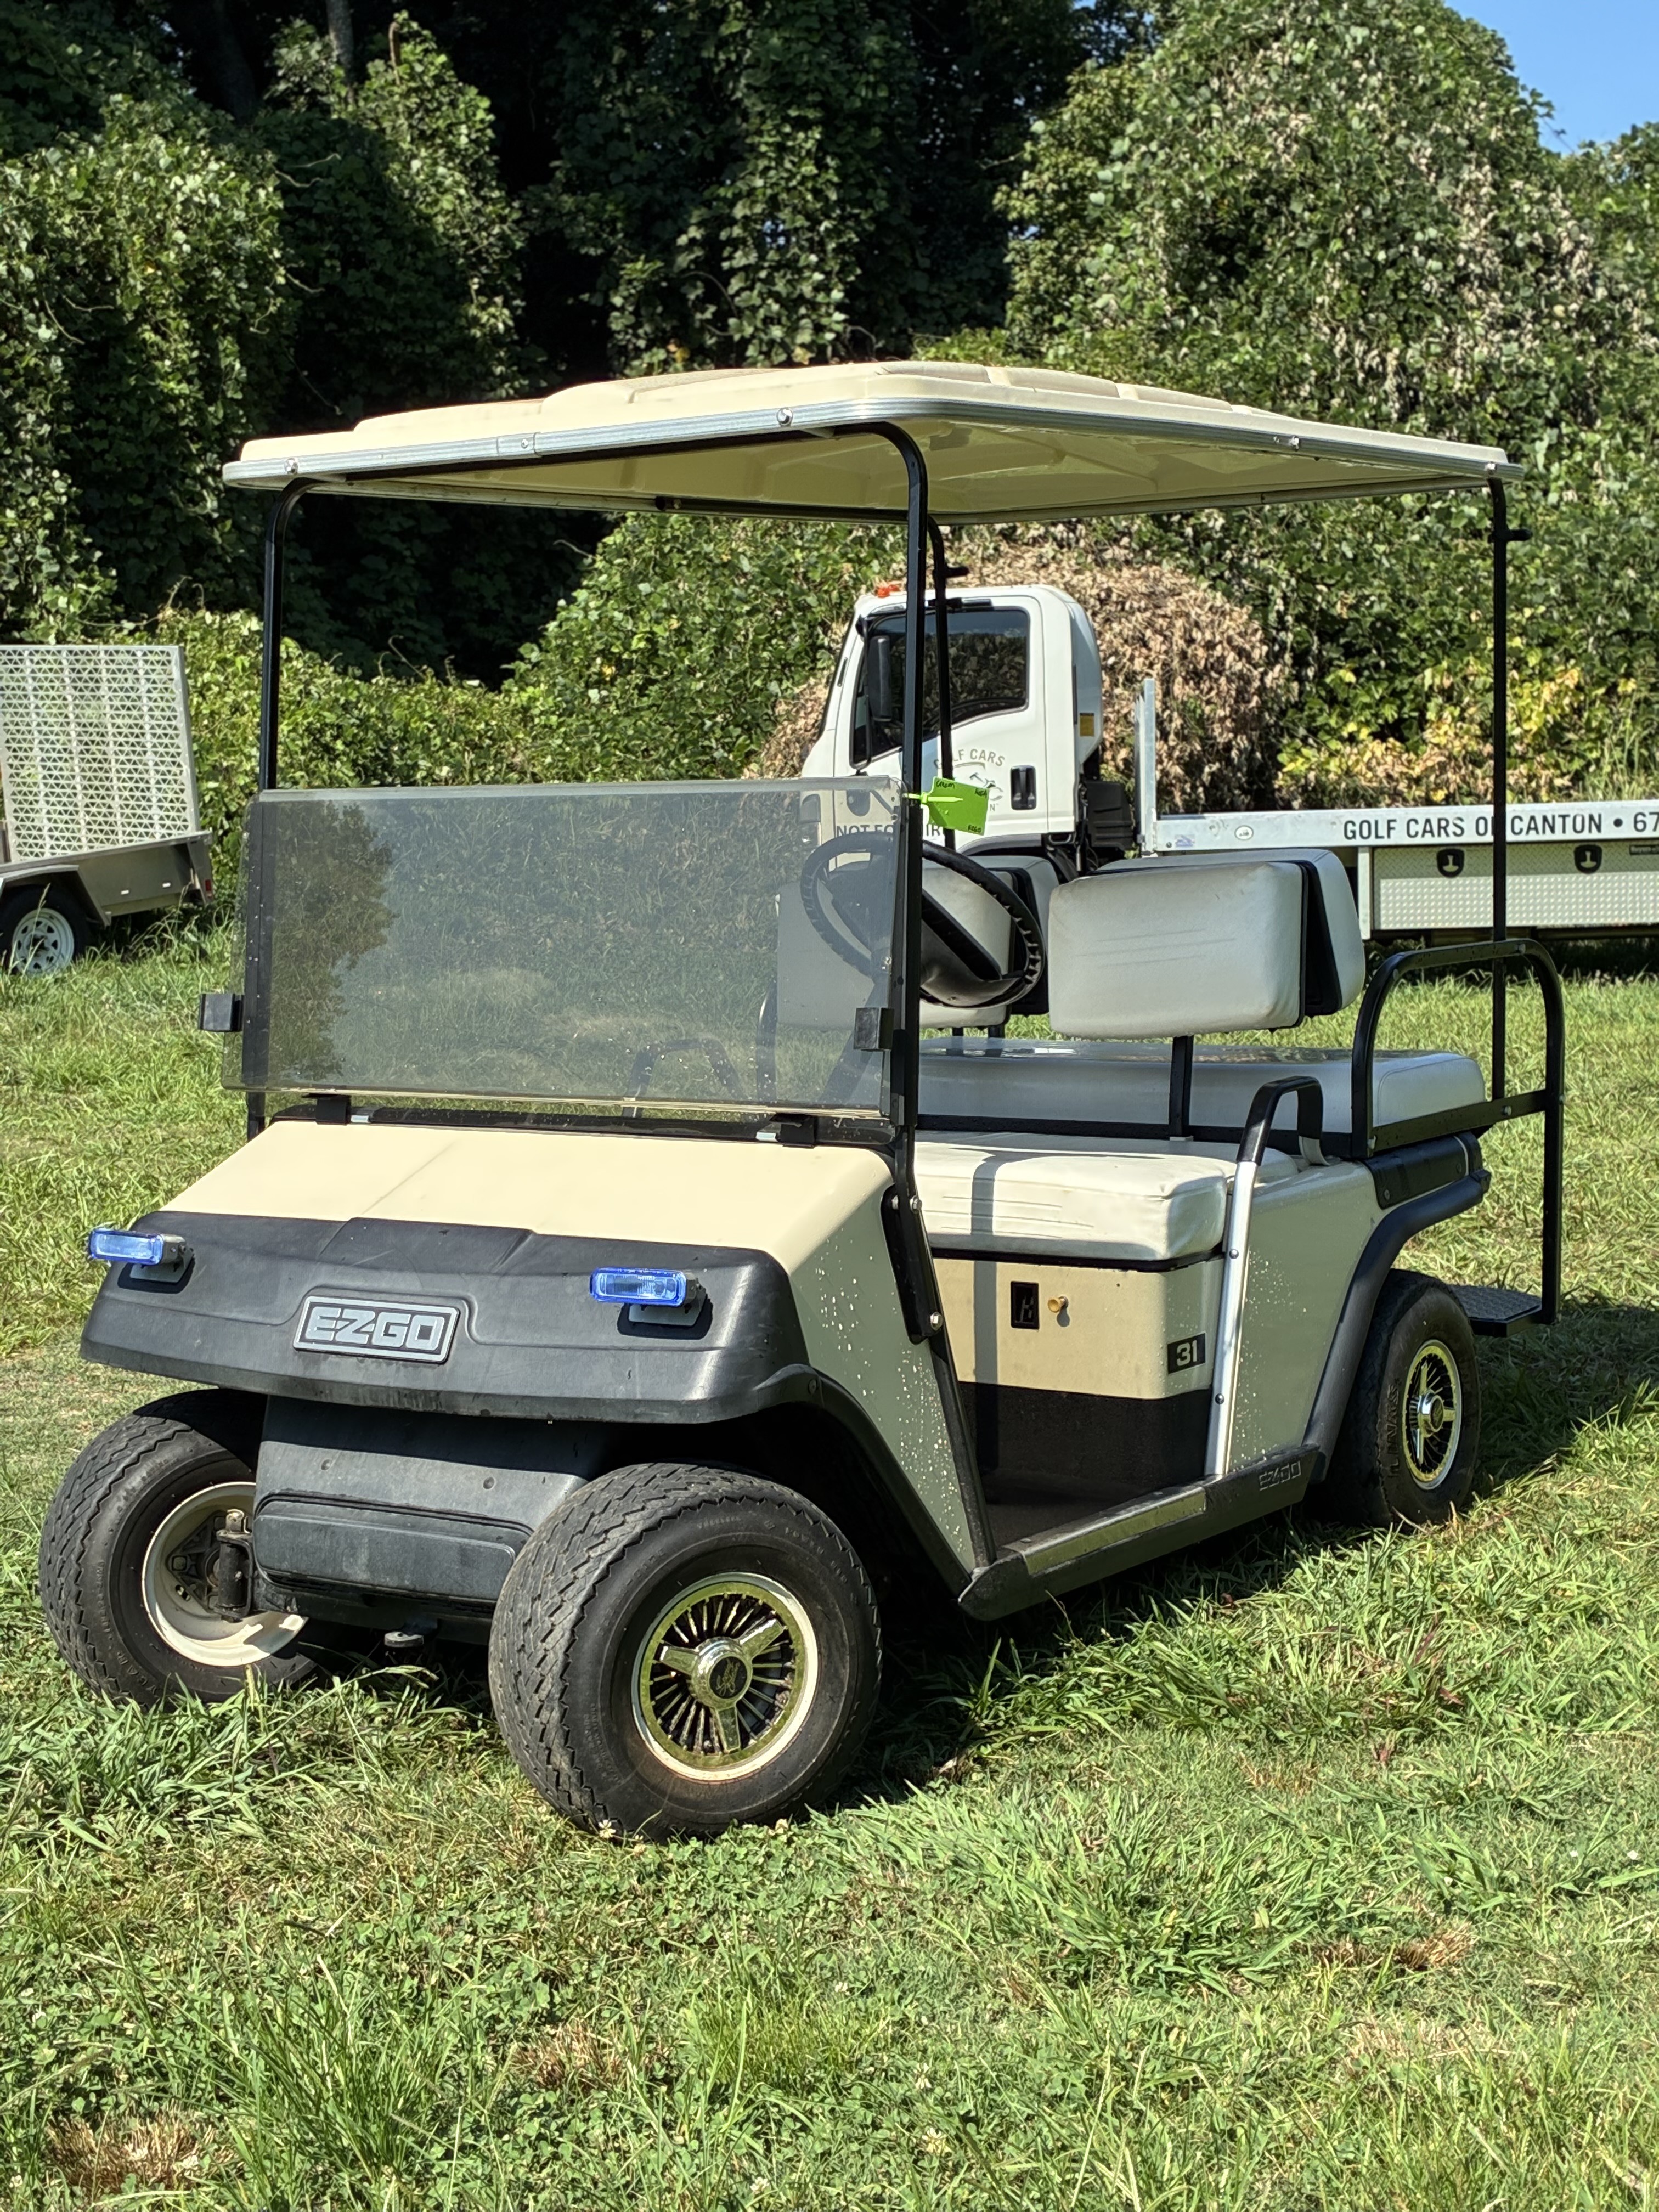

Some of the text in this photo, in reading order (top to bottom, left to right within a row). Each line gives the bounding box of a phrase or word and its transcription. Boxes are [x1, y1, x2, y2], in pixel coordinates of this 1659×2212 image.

[970, 748, 1005, 766] CARS
[874, 823, 894, 834] FO
[1344, 818, 1397, 840] GOLF
[1406, 816, 1465, 839] CARS
[1475, 816, 1494, 837] O
[1510, 812, 1602, 836] CANTON
[305, 1306, 445, 1351] EZGO
[1176, 1339, 1198, 1367] 31
